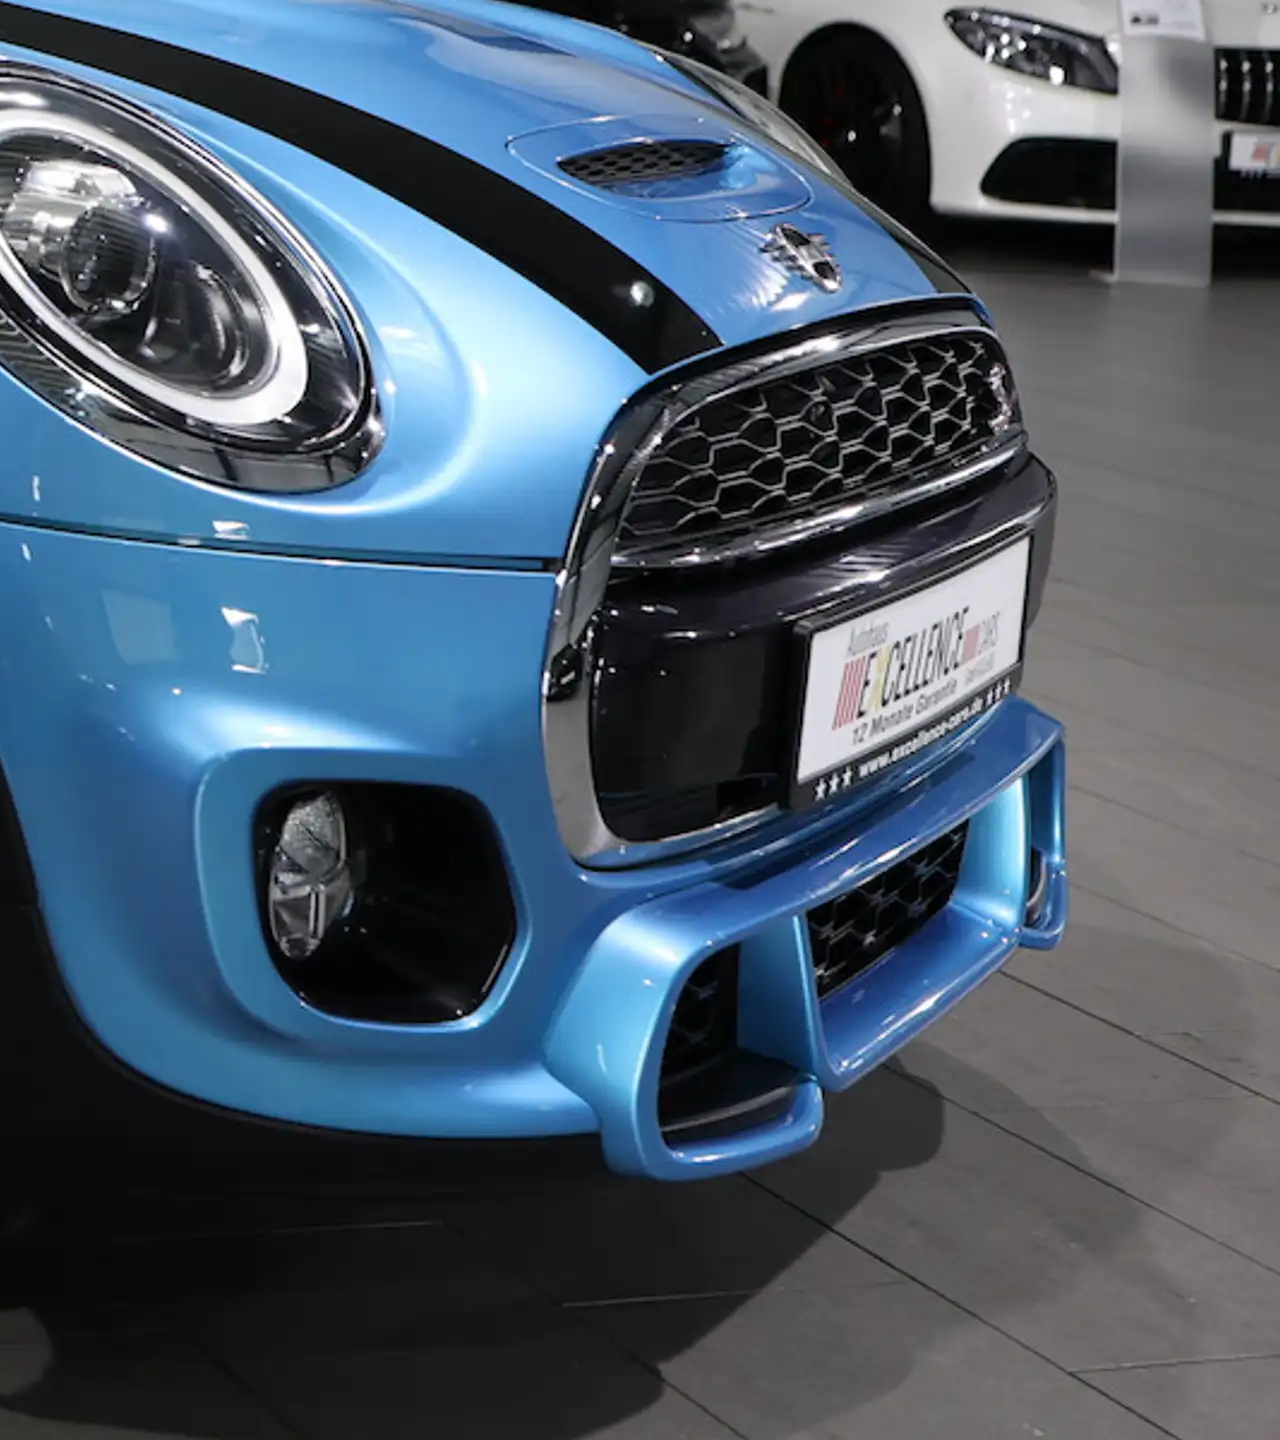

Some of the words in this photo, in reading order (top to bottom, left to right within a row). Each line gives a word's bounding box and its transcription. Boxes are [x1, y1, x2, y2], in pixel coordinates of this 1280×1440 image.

[856, 606, 970, 719] EXCELLENCE
[853, 722, 869, 744] 12
[869, 704, 914, 737] Monate
